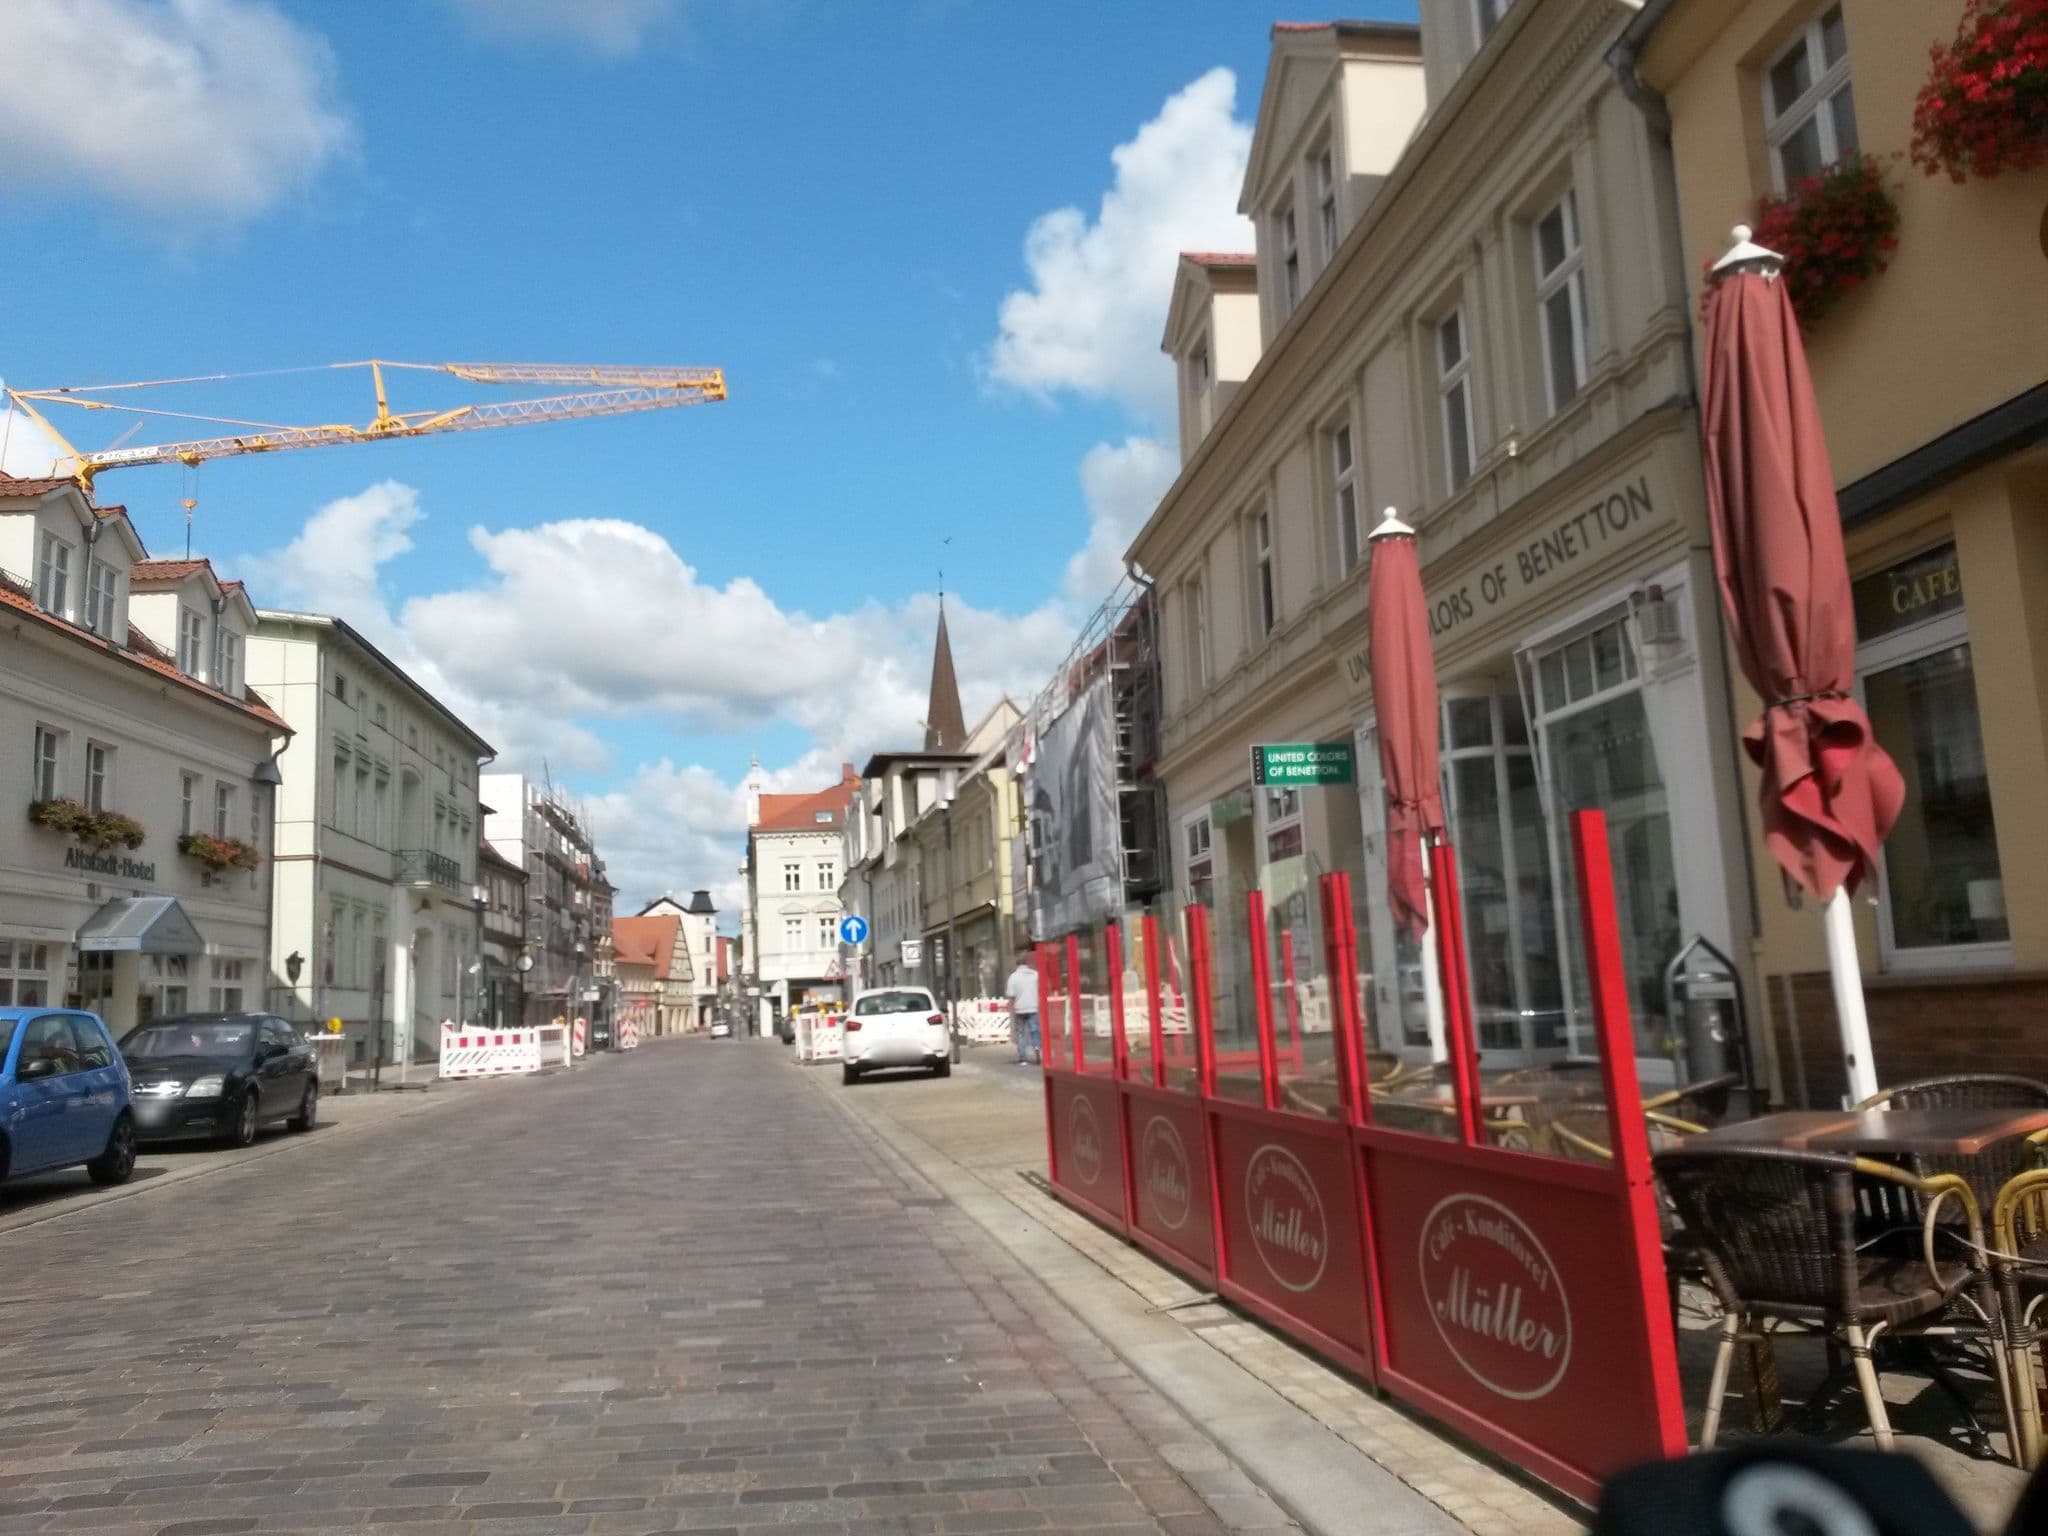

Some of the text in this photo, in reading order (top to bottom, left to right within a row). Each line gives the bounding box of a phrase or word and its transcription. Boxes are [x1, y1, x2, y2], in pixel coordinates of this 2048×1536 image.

[1428, 476, 1654, 638] LORS OF BENETTON
[1267, 751, 1348, 763] UNITED COLORS
[1269, 765, 1284, 777] OF
[64, 847, 156, 882] Altstadt-Hotel
[1254, 1197, 1322, 1262] Müller
[1436, 1264, 1567, 1359] Müller
